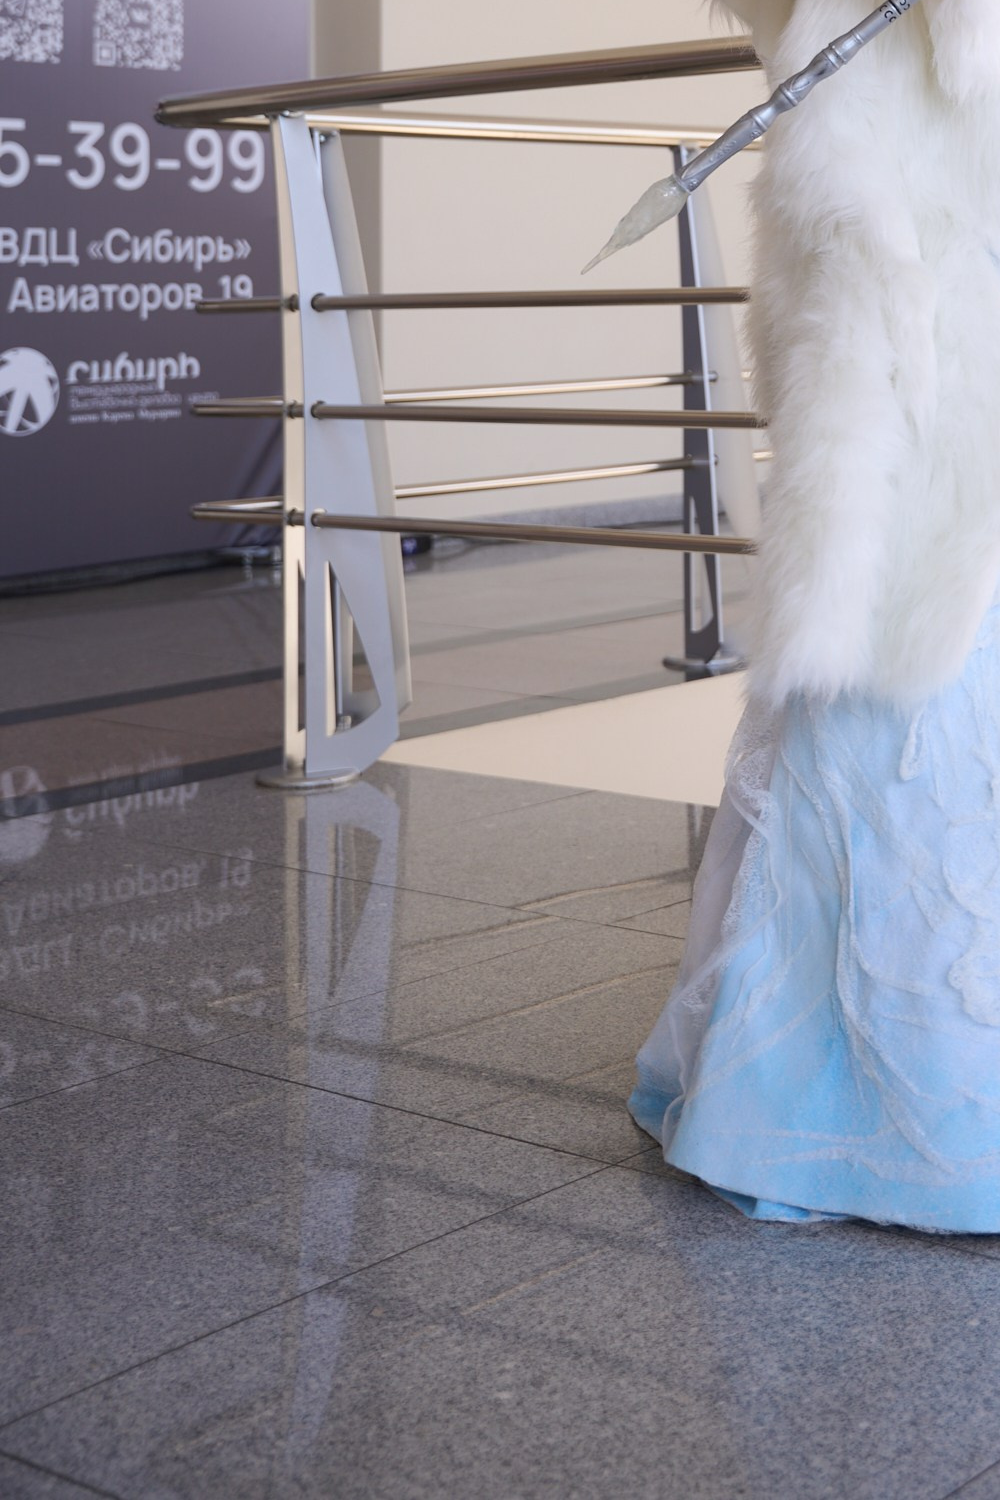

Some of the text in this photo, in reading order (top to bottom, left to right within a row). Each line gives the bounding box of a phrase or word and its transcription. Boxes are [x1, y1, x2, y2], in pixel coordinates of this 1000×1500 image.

[0, 227, 252, 272] ВДЦ «Сибирь»
[217, 274, 253, 300] 19
